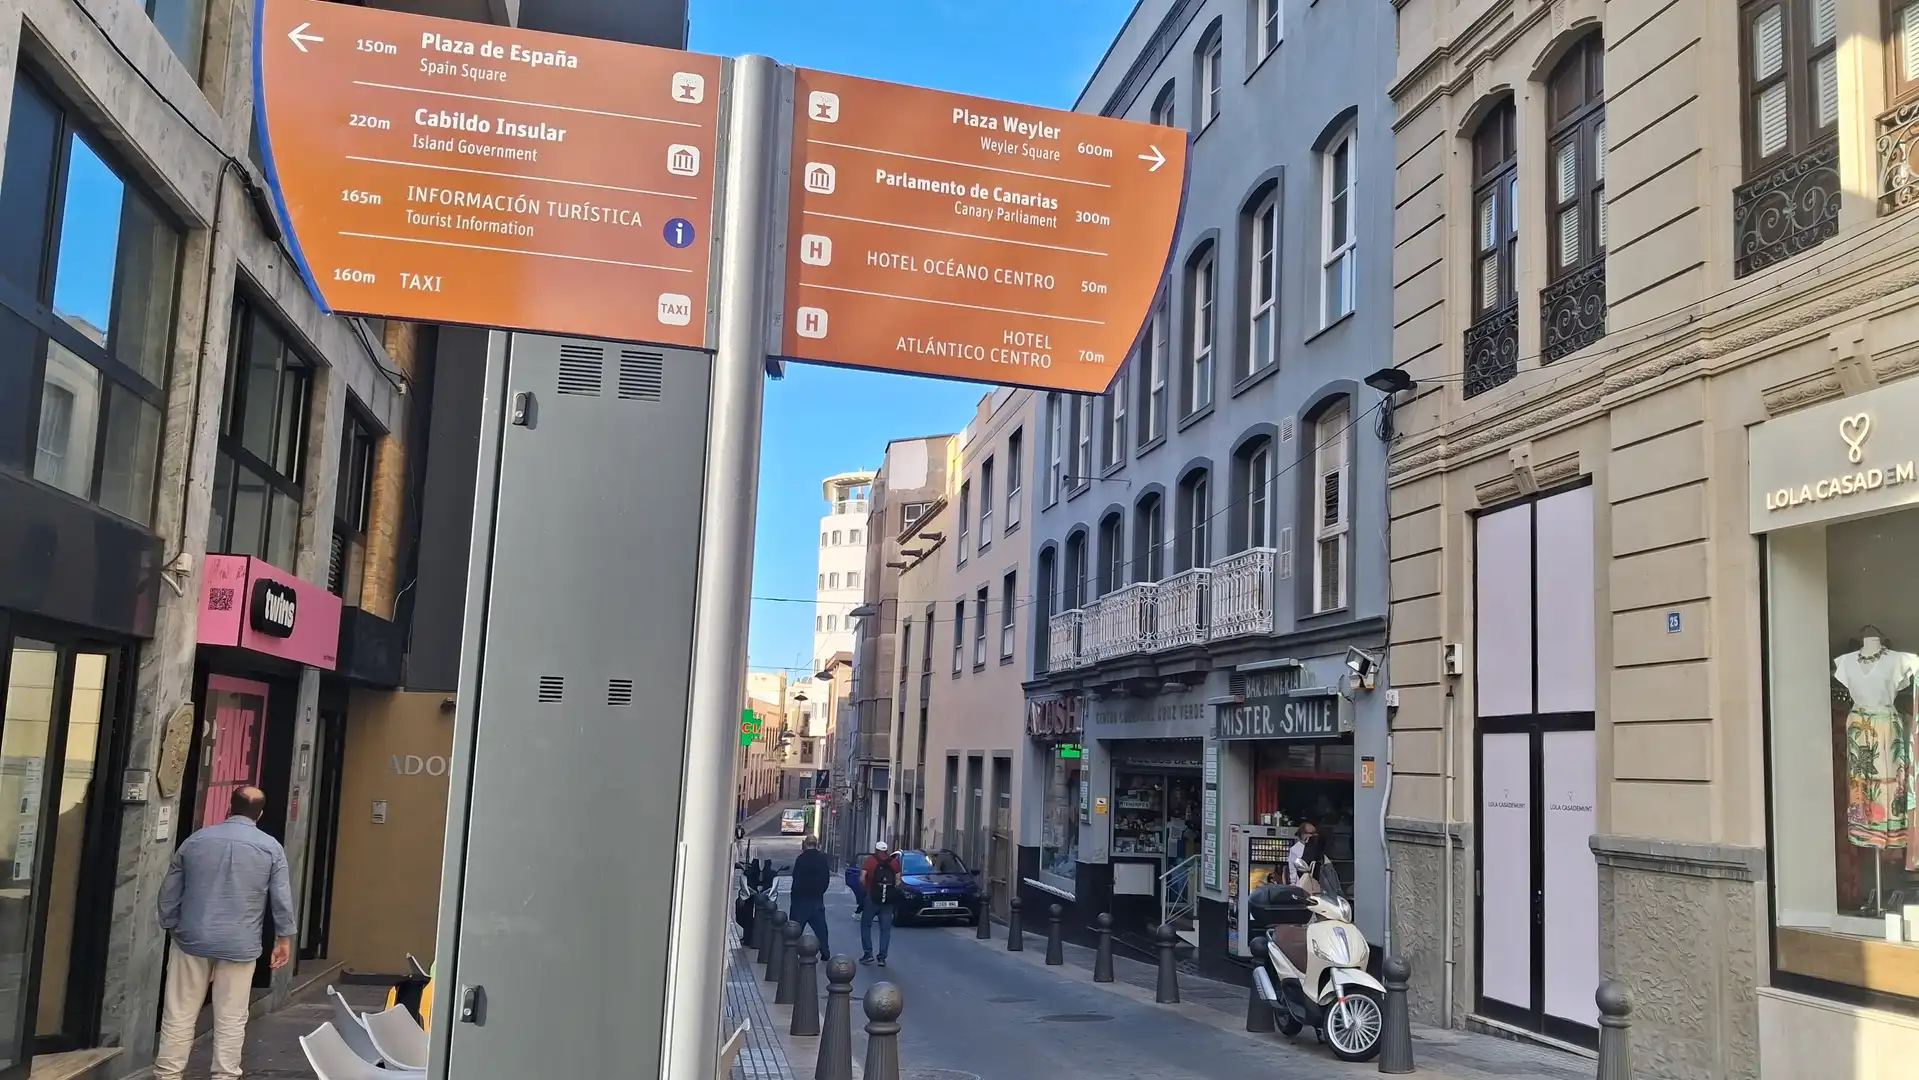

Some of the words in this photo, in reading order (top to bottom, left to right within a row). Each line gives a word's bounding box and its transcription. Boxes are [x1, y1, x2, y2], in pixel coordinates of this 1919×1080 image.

[357, 39, 397, 54] 150m
[422, 32, 474, 57] Plaza
[480, 41, 504, 58] de
[511, 45, 577, 68] España
[420, 58, 456, 76] Spain
[461, 64, 506, 82] Square
[349, 114, 390, 130] 220m
[415, 109, 490, 132] Cabildo
[496, 118, 566, 141] Insular
[953, 108, 997, 129] Plaza
[1003, 116, 1060, 139] Weyler
[412, 134, 453, 151] Island
[458, 140, 537, 162] Government
[981, 137, 1018, 155] Weyler
[1022, 143, 1060, 161] Square
[1078, 142, 1112, 157] 600m
[341, 189, 381, 204] 165m
[876, 169, 965, 196] Parlamento
[970, 183, 988, 199] de
[993, 187, 1058, 209] Canarias
[407, 186, 539, 215] INFORMACIÓN
[547, 202, 641, 227] TURÍSTICA
[955, 201, 993, 221] Canary
[997, 207, 1057, 228] Parliament
[1076, 210, 1110, 225] 300m
[406, 209, 452, 228] Tourist
[456, 215, 533, 236] Information
[809, 241, 823, 259] H
[334, 268, 376, 284] 160m
[868, 251, 917, 271] HOTEL
[924, 258, 988, 281] OCÉANO
[994, 269, 1054, 289] CENTRO
[400, 272, 442, 292] TAXI
[1081, 281, 1107, 294] 50m
[660, 303, 688, 316] TAXI
[805, 314, 818, 331] H
[1004, 330, 1052, 349] HOTEL
[896, 336, 984, 360] ATLÁNTICO
[991, 348, 1051, 368] CENTRO
[1079, 350, 1104, 363] 70m
[1766, 484, 1812, 510] LOLA
[265, 588, 295, 628] twins
[1669, 615, 1679, 628] 25
[1246, 676, 1261, 698] BAR
[1180, 702, 1205, 720] VERDE
[1220, 703, 1275, 736] MISTER
[1280, 700, 1332, 733] SMILE
[387, 754, 453, 777] ADO
